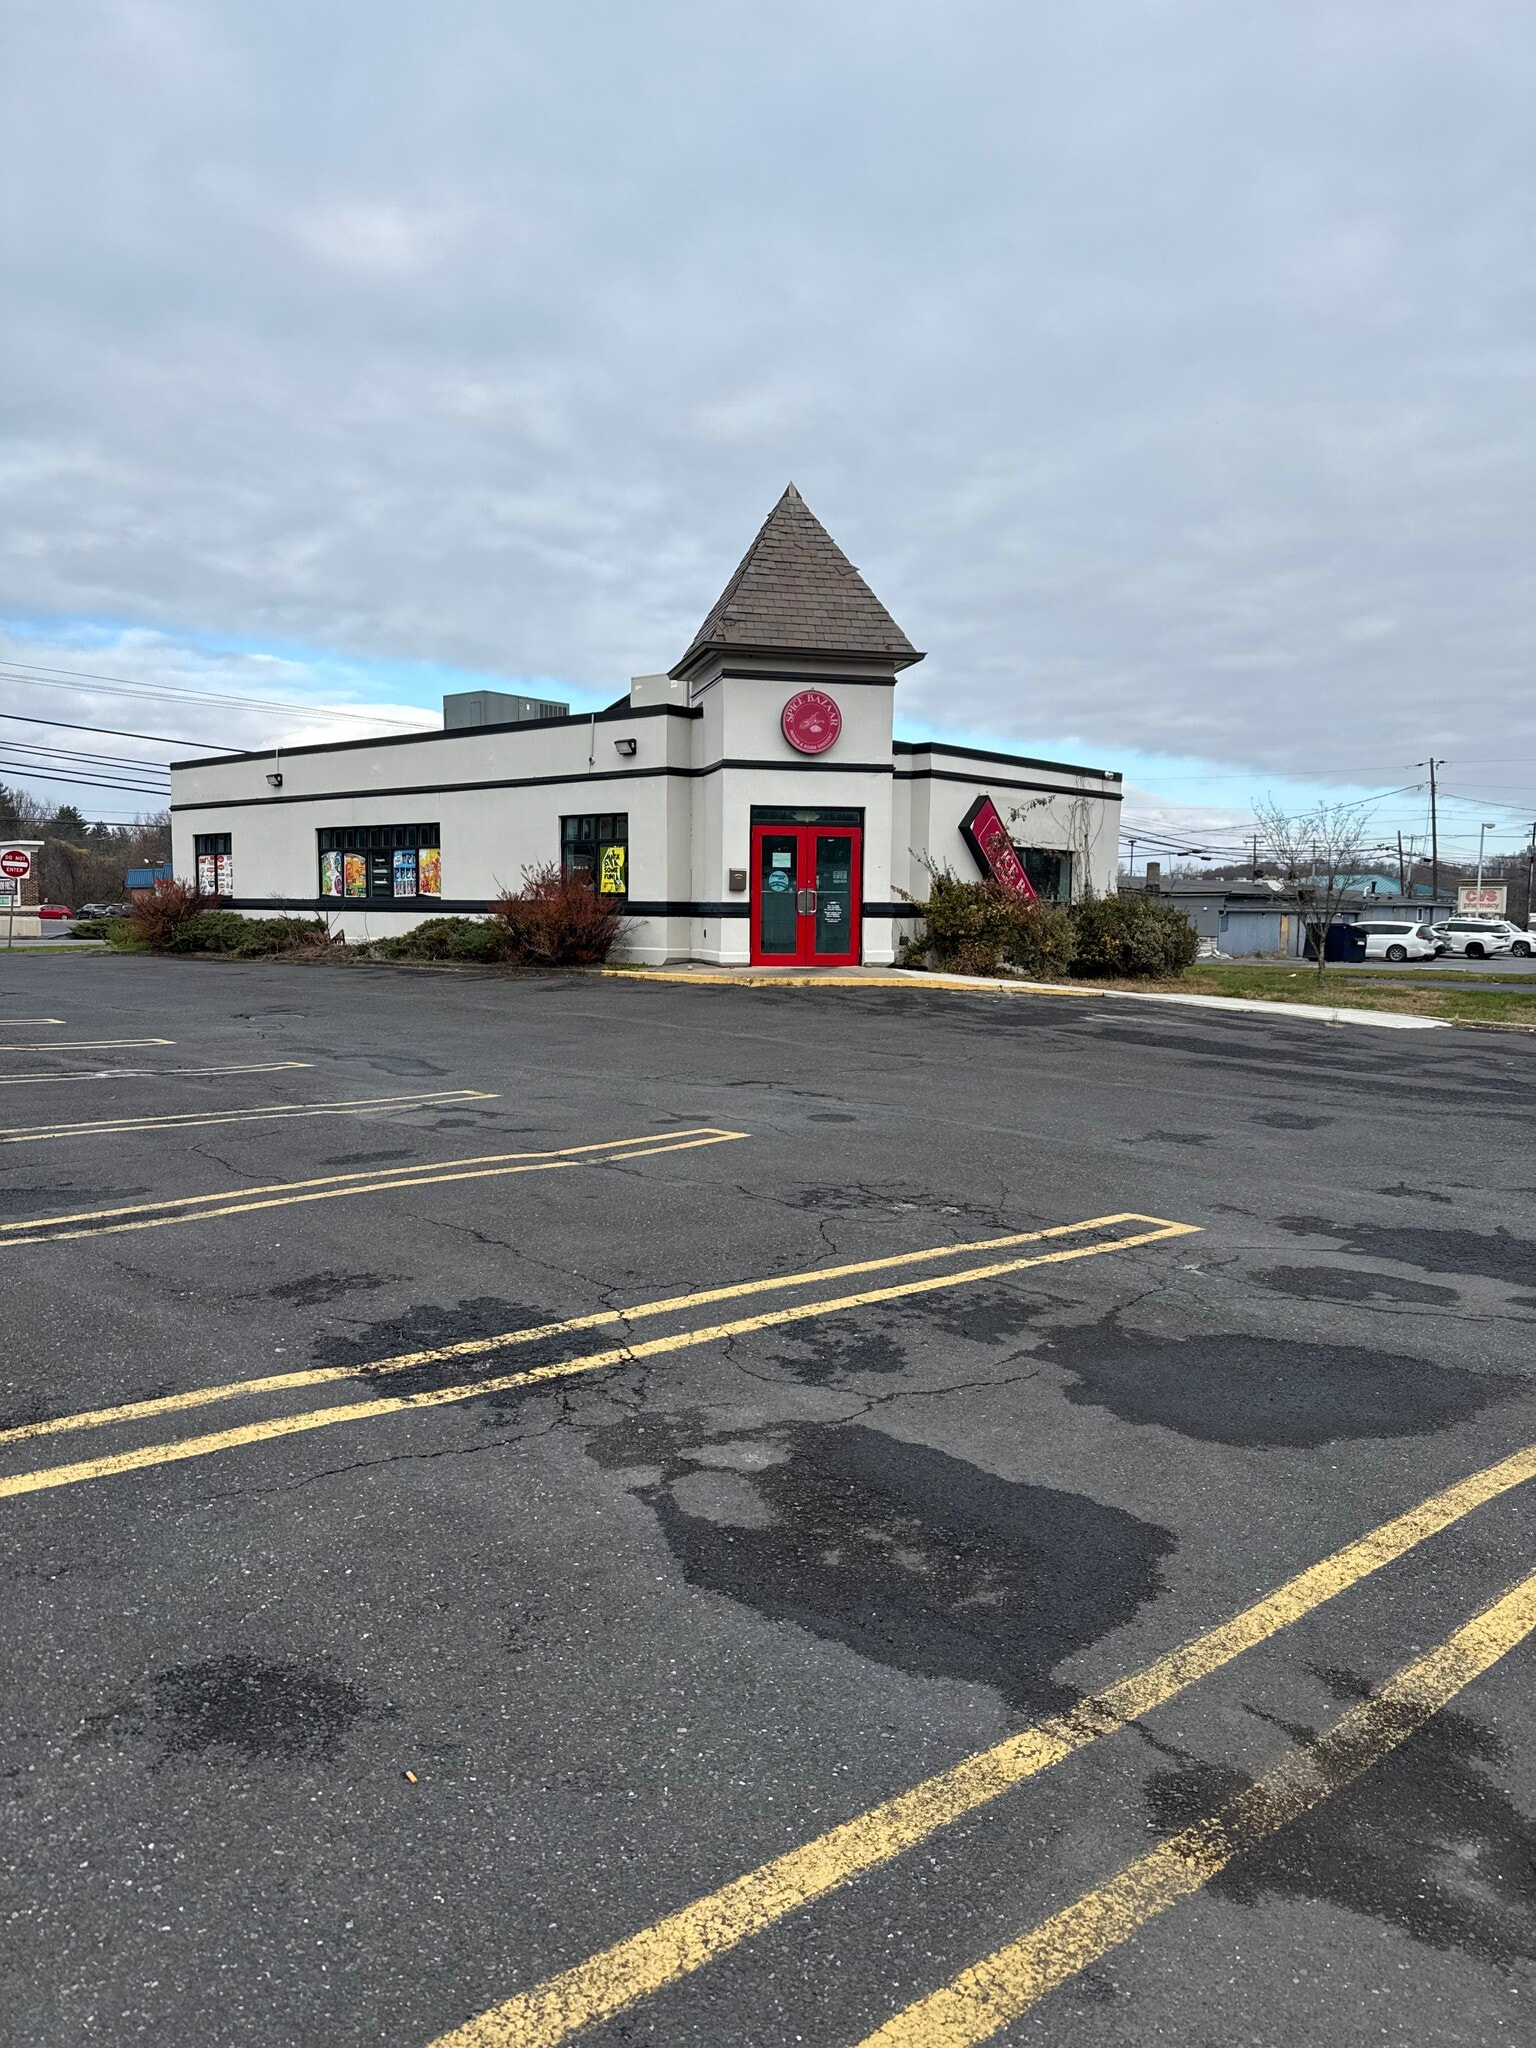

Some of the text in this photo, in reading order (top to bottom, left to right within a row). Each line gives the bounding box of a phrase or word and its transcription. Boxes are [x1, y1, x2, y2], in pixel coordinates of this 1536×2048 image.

[786, 694, 838, 726] SPICE BAZAAR
[816, 732, 832, 748] GROCERY
[1466, 890, 1498, 902] CVS
